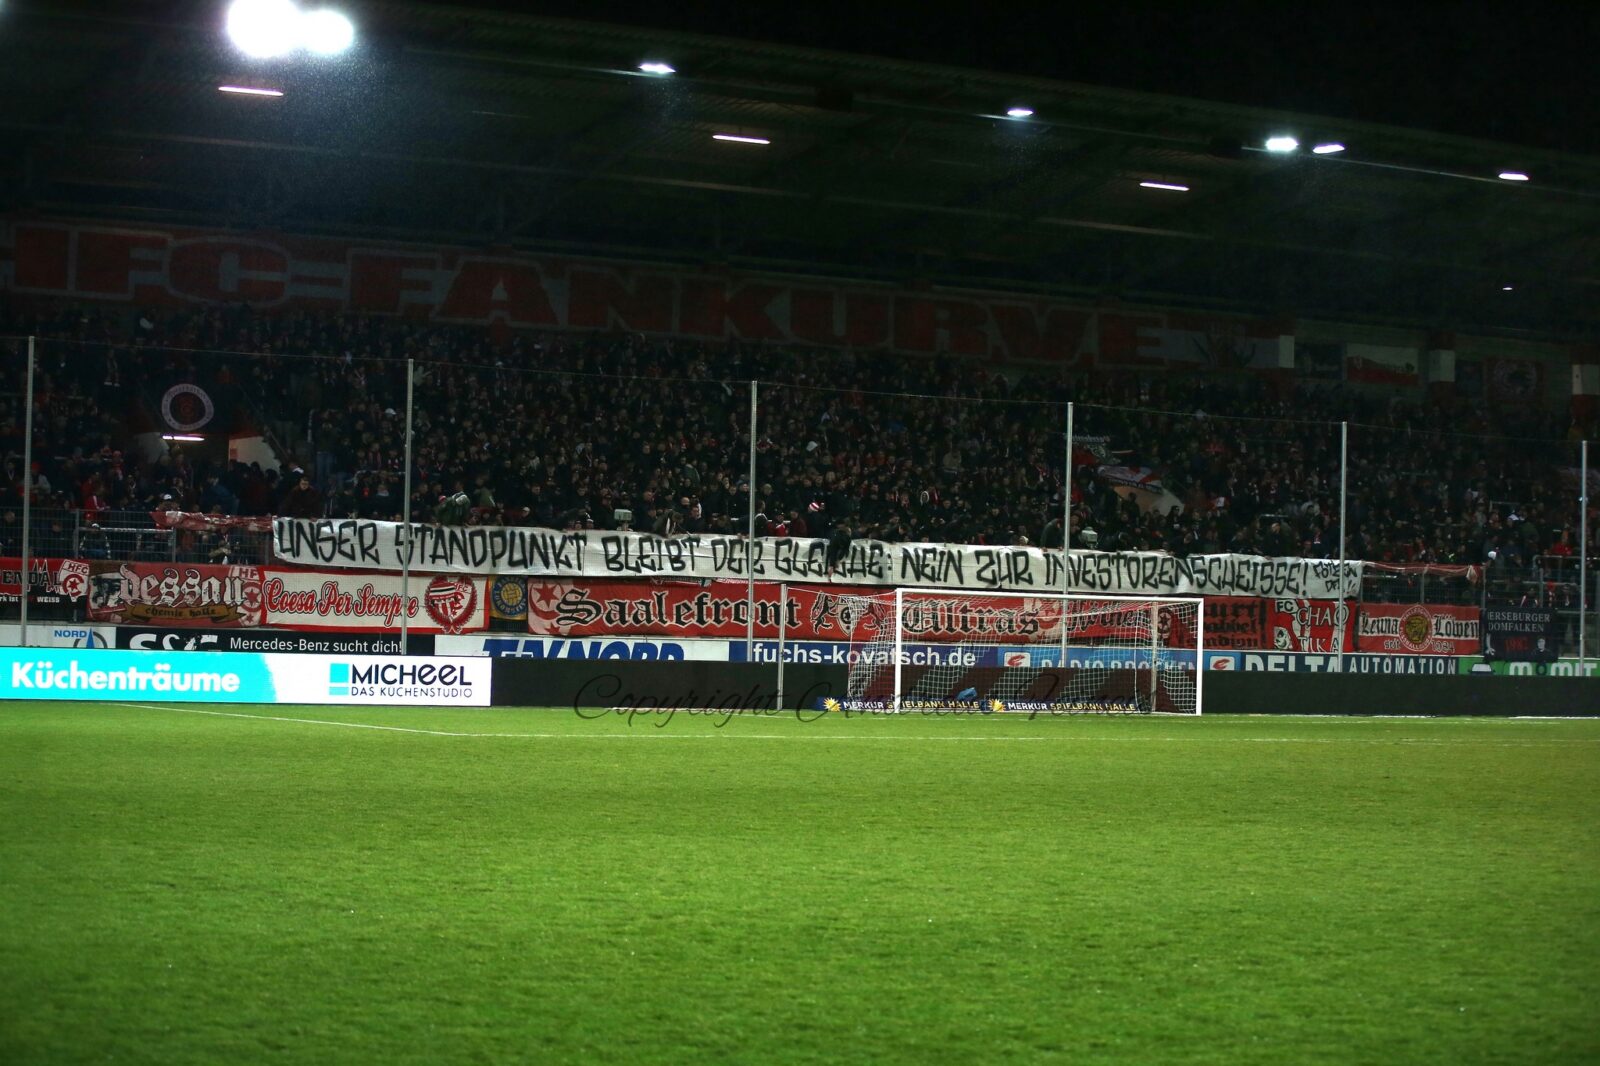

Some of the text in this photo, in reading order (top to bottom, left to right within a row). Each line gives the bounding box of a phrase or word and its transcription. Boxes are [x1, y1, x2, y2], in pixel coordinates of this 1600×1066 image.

[278, 520, 380, 564] UNSER
[395, 523, 588, 571] STANDPUNKT
[602, 536, 701, 573] BLEIBT
[711, 539, 765, 574] DER
[901, 547, 964, 584] NEIN
[975, 549, 1033, 587] ZUR
[1043, 550, 1310, 597] INVESTORENSCHEISSE!
[67, 562, 89, 575] HFC
[317, 581, 353, 617] Per
[353, 583, 419, 627] Sempe
[555, 586, 803, 630] Saalefront
[1276, 600, 1294, 613] FC
[1487, 610, 1551, 623] ERSEBURGER
[54, 630, 87, 638] NORD
[230, 637, 402, 653] Mercedes-Benz sucht dich!
[1349, 656, 1457, 674] AUTOMATION
[12, 661, 241, 692] Küchenträume
[351, 687, 375, 697] DAS
[843, 701, 980, 710] MERKUR SIELBANK HALLE
[1007, 702, 1137, 712] MERKUR SPIELBANK HALLE
